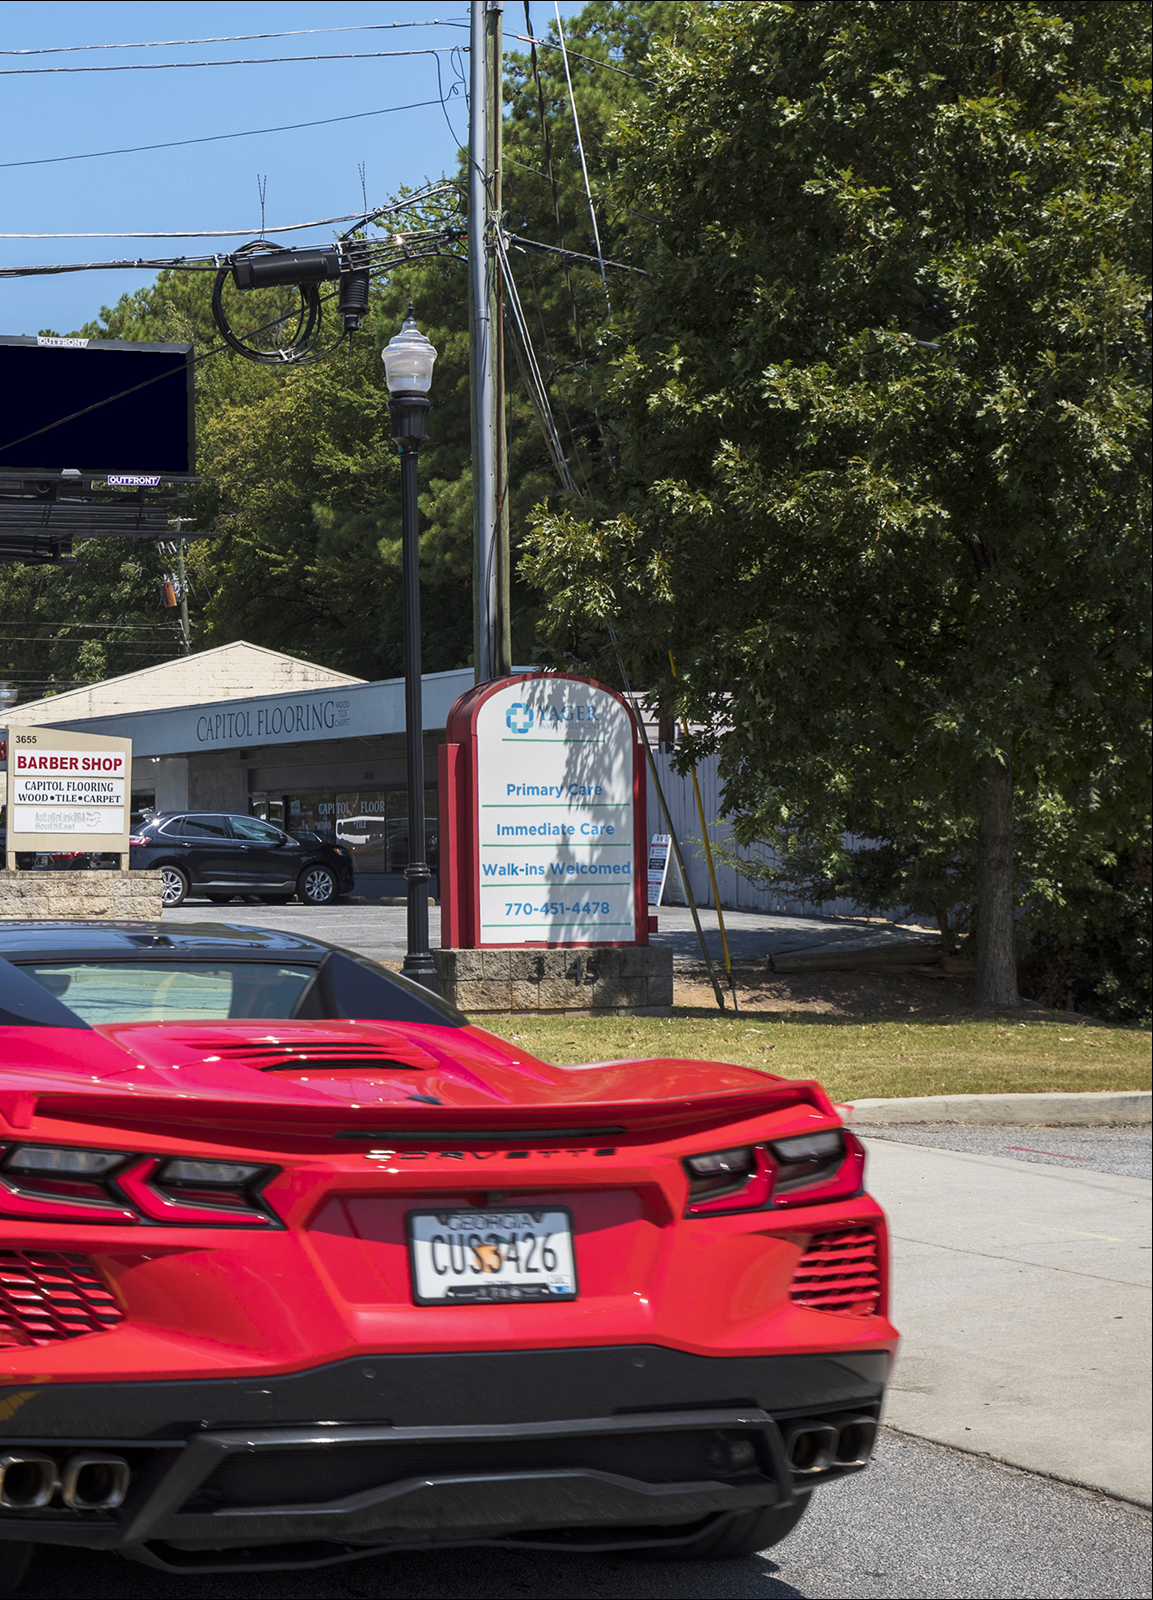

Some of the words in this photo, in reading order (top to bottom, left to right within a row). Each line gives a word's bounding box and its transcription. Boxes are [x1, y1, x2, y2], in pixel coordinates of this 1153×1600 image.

[38, 337, 87, 347] OUTFRONT
[109, 476, 158, 485] OUTFRONT
[335, 700, 350, 709] WOOD
[538, 705, 600, 721] YAGER
[196, 711, 252, 742] CAPITOL
[257, 700, 335, 736] FLOORING
[15, 735, 37, 744] 3655
[17, 755, 79, 770] BARBER
[81, 757, 123, 771] SHOP
[24, 781, 65, 791] CAPITOL
[66, 782, 114, 792] FLOORING
[507, 783, 564, 798] Primary
[568, 783, 603, 796] Care
[18, 793, 49, 803] WOOD
[55, 794, 78, 803] TILE
[83, 795, 121, 803] CARPET
[497, 823, 576, 836] Immediate
[580, 823, 615, 835] Care
[482, 863, 546, 876] Walk-ins
[550, 861, 631, 875] Welcomed
[504, 902, 610, 916] 770-451-4478
[449, 1214, 535, 1231] GEORGIA
